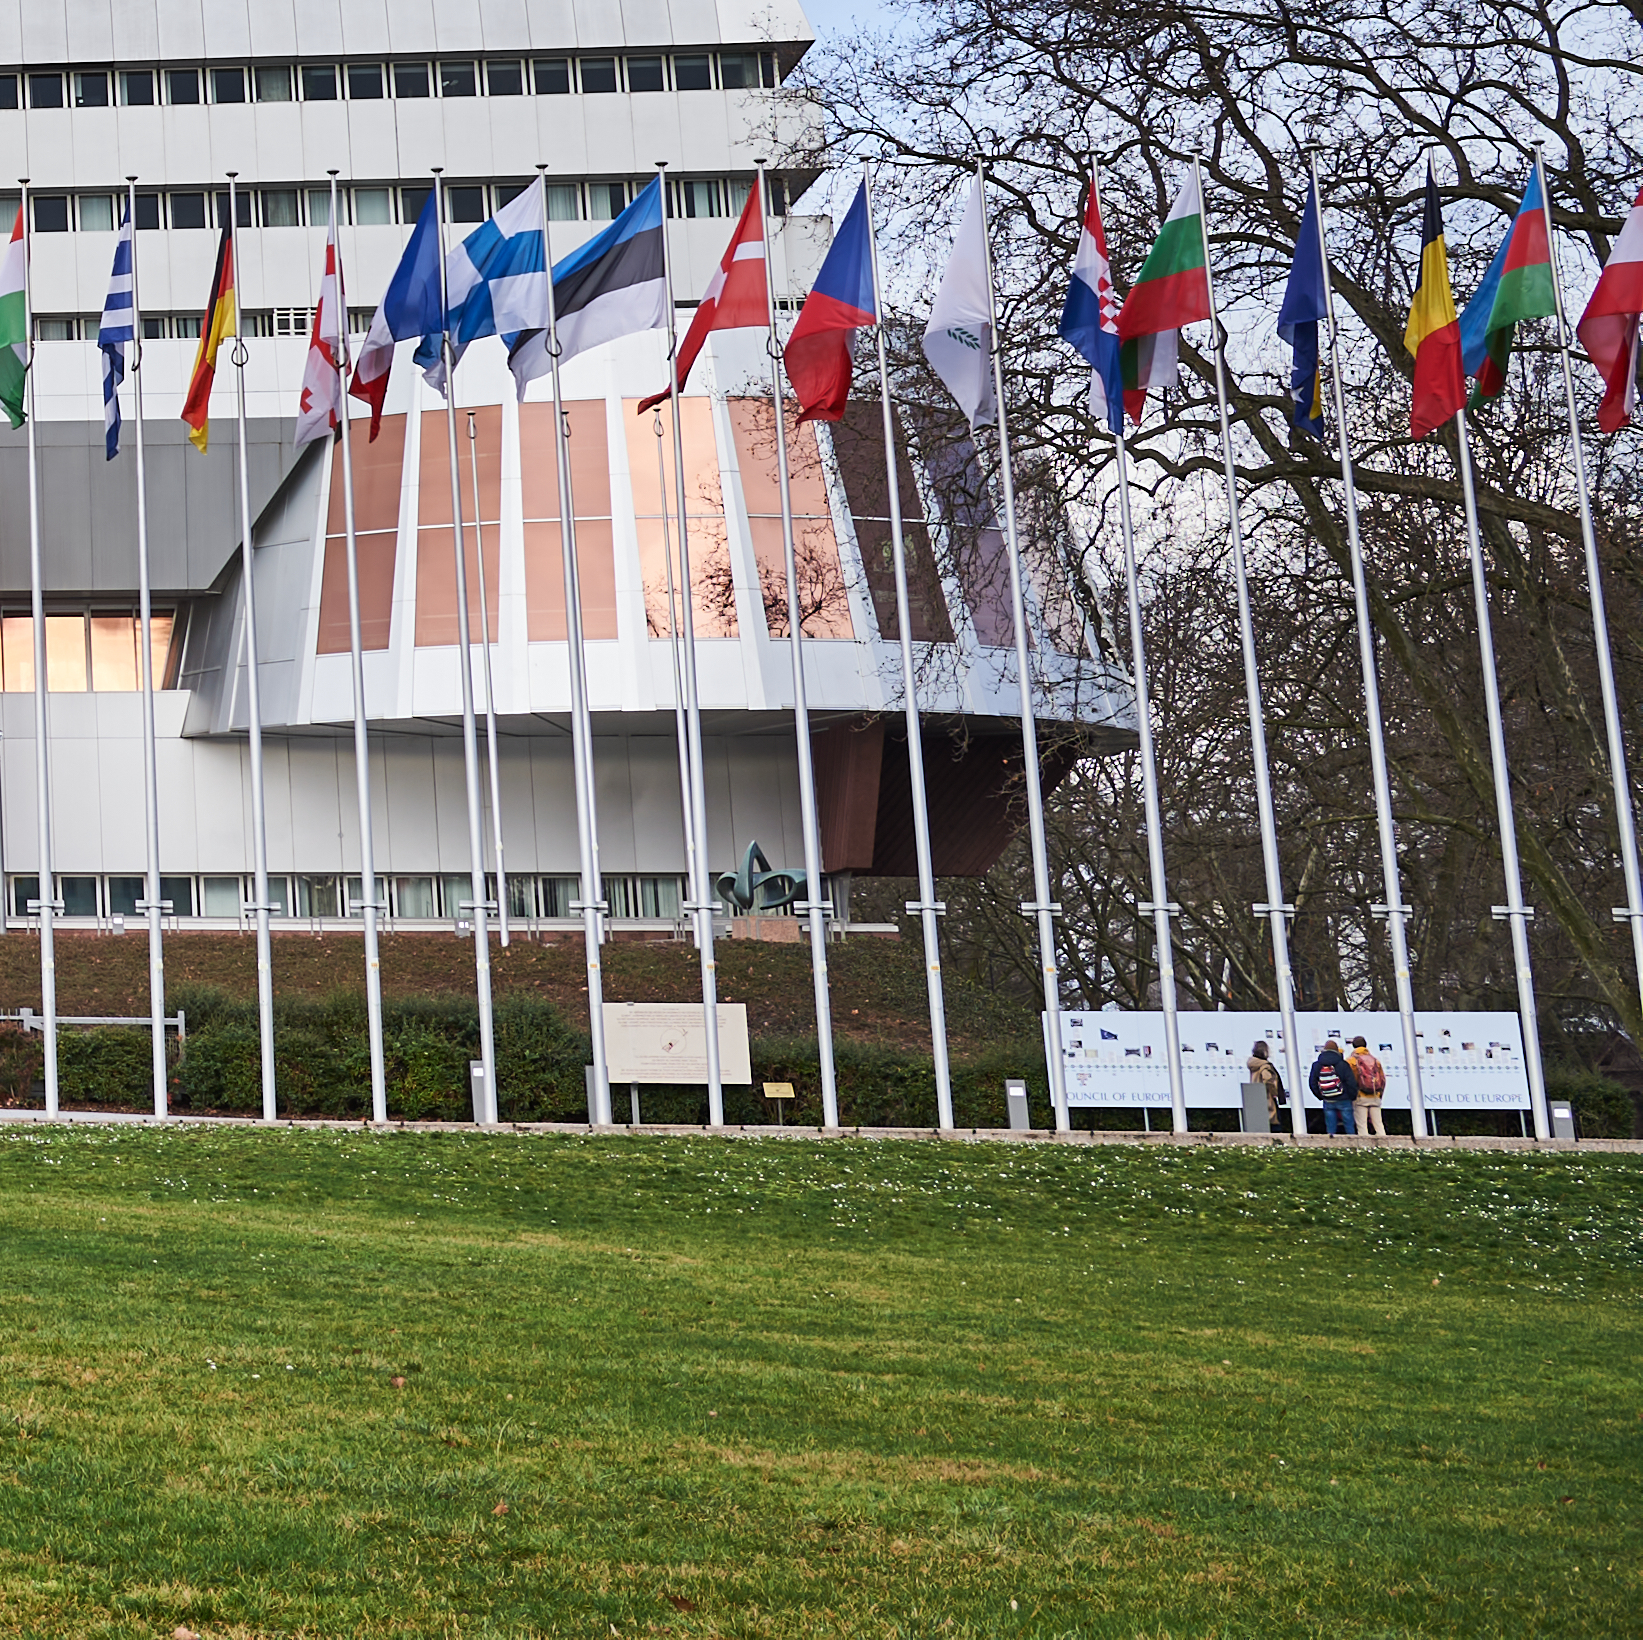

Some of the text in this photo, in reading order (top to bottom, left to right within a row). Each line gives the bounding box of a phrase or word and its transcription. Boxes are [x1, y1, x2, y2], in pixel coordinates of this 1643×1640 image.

[1066, 1092, 1172, 1102] OUNCIL OF EUROPE
[1406, 1093, 1523, 1103] CNSEIL DE L'EUROPE
